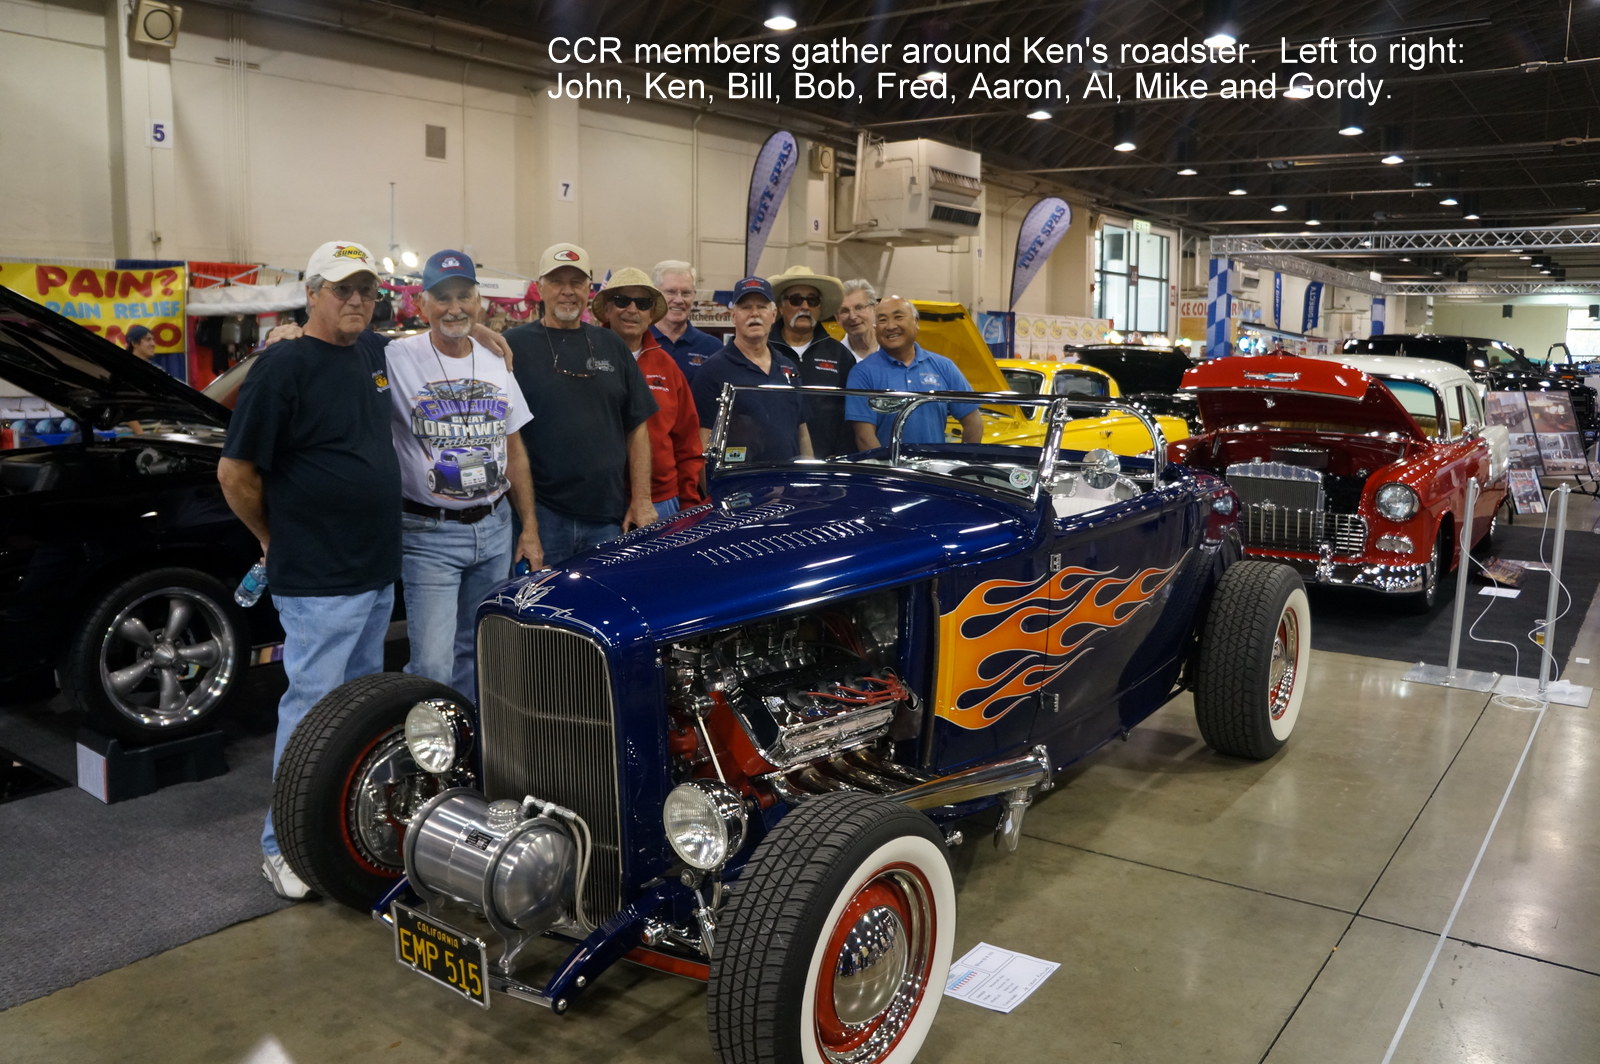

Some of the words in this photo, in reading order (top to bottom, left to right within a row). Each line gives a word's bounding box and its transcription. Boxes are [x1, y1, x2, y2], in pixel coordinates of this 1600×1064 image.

[153, 124, 165, 142] 5
[561, 183, 570, 197] 7
[750, 185, 775, 234] TUFF
[769, 140, 793, 186] SPAS
[813, 219, 820, 231] 9
[1018, 235, 1042, 270] TUFF
[1040, 204, 1066, 237] SPAS
[36, 265, 178, 298] PAIN?
[46, 301, 102, 320] PAIN
[113, 301, 181, 319] RELIEF
[688, 312, 714, 322] itchen
[1181, 302, 1191, 317] CE
[1192, 302, 1208, 317] COL
[412, 416, 507, 437] NORTHWES
[416, 921, 459, 949] CALIFORNIA
[400, 927, 439, 971] EMP
[445, 950, 482, 996] 515
